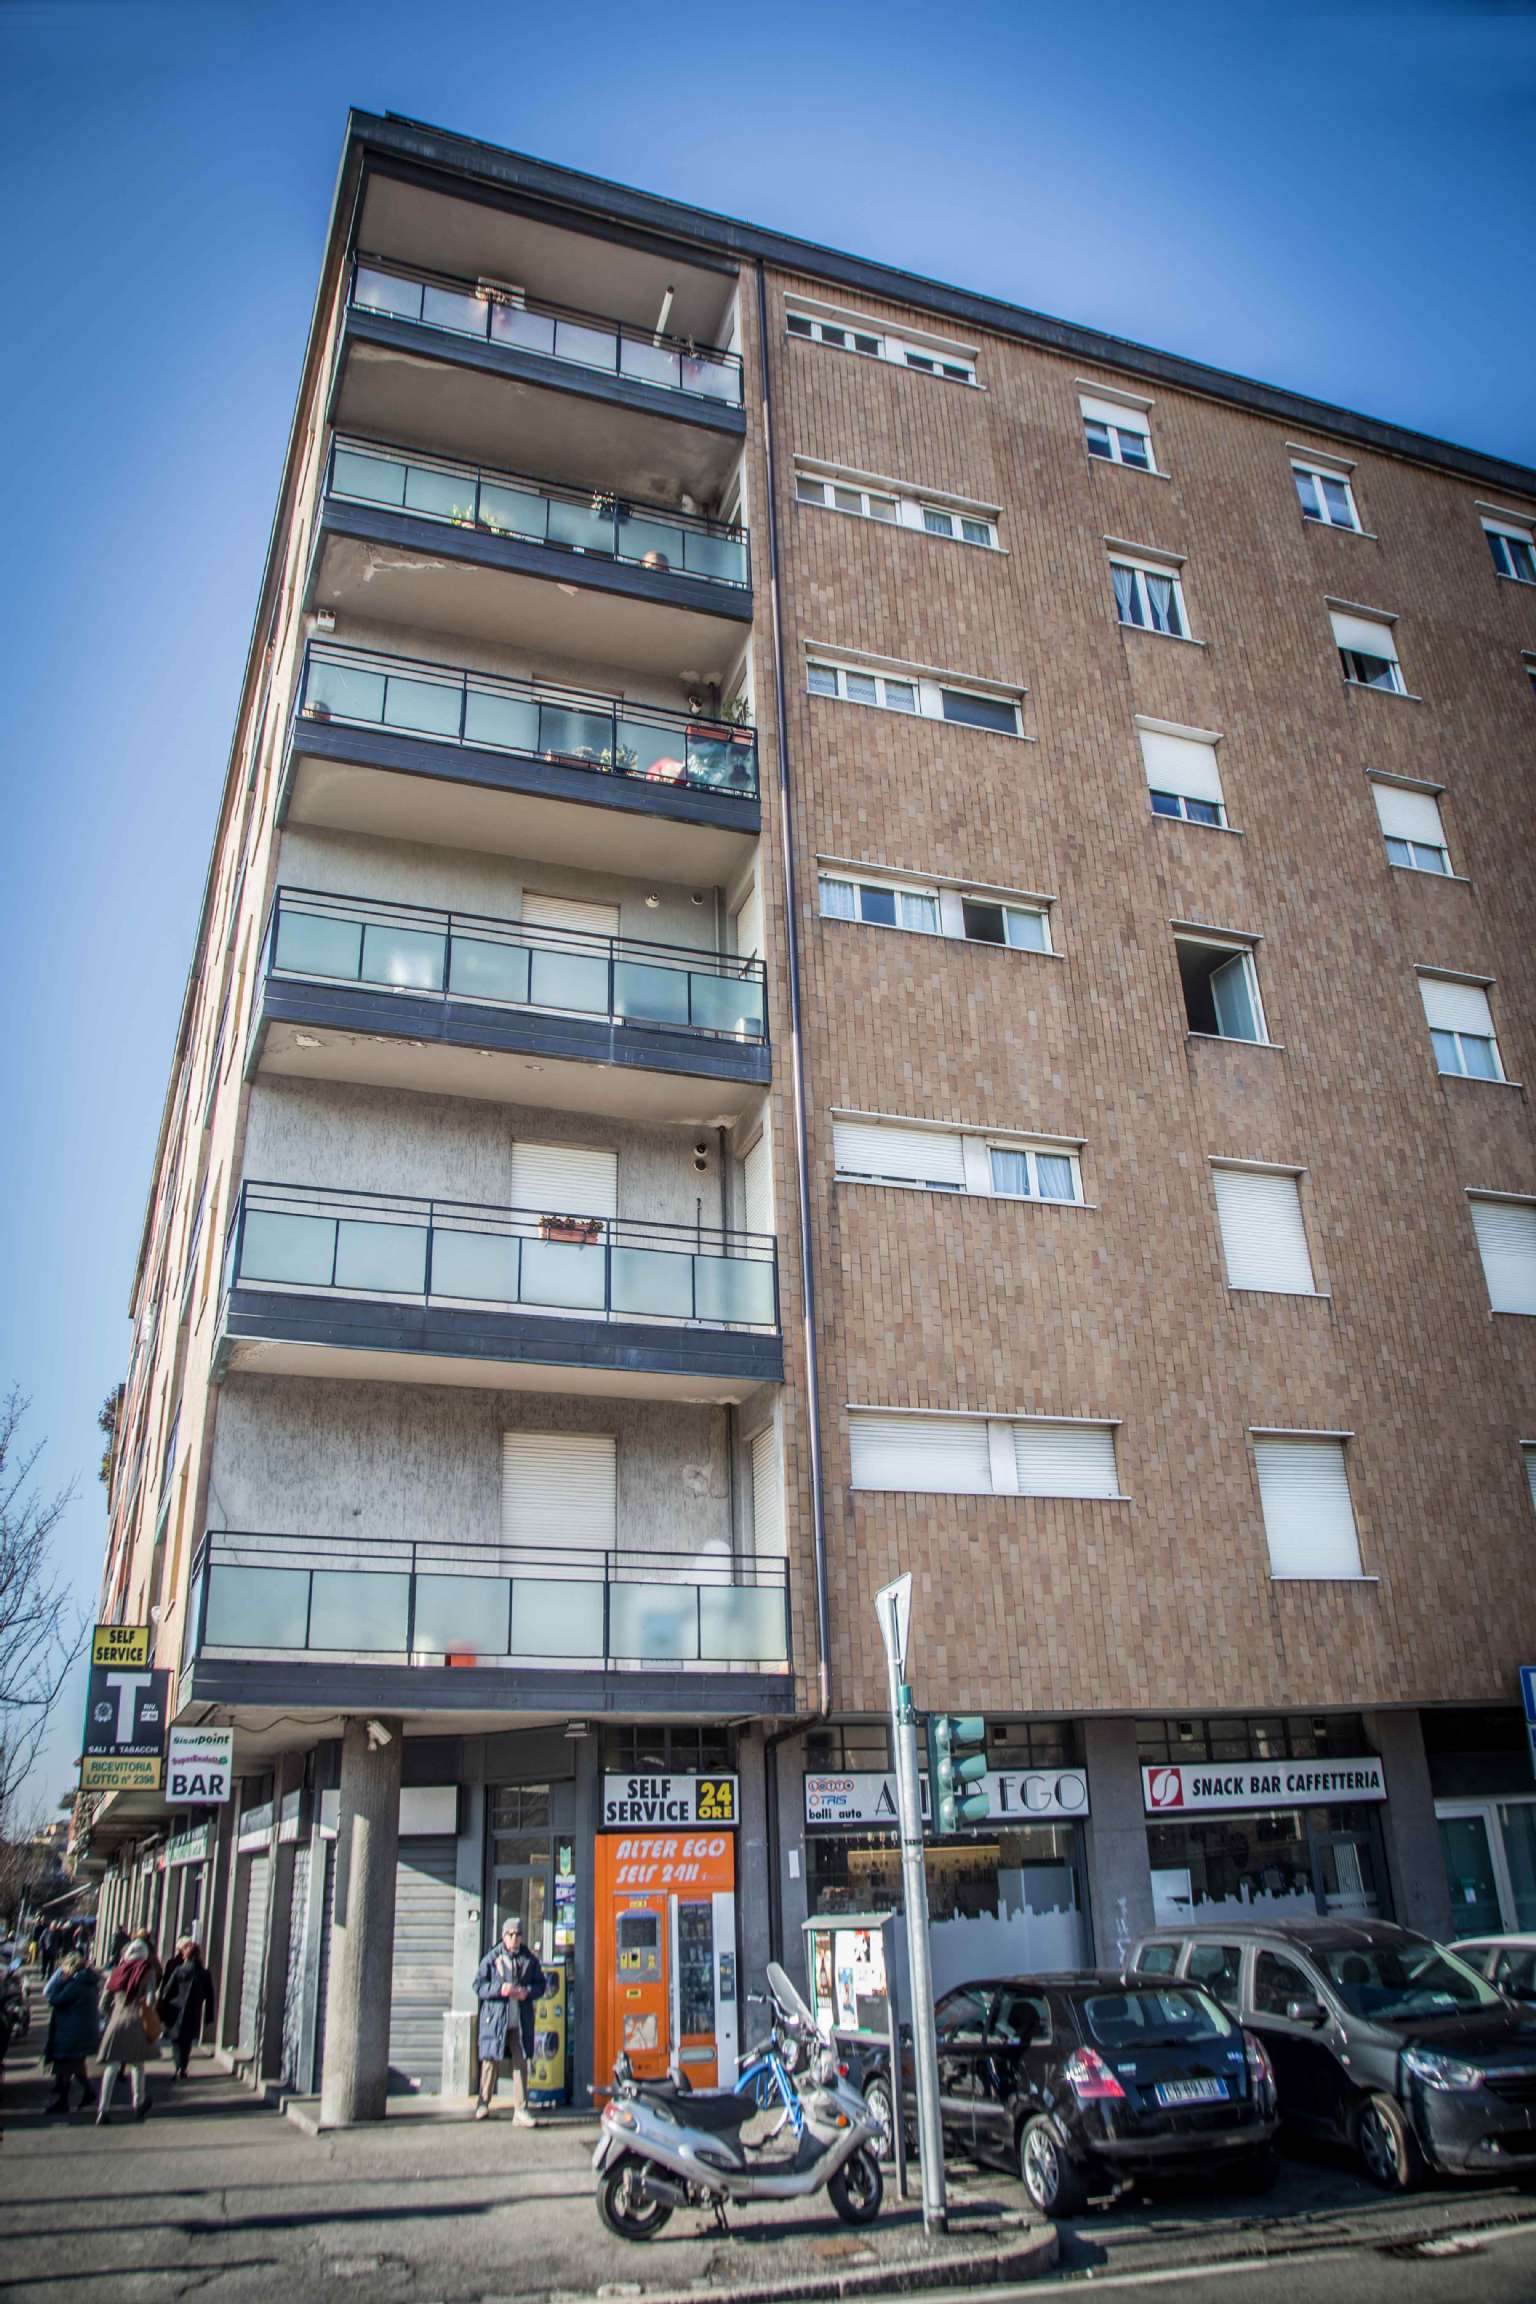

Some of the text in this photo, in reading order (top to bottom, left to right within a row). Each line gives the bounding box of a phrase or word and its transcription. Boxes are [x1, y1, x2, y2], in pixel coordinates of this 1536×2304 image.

[109, 1629, 135, 1644] SELF
[96, 1646, 143, 1662] SERVICE
[106, 1672, 152, 1743] T
[88, 1745, 107, 1754] SALI
[120, 1745, 159, 1754] TABACCHI
[90, 1762, 152, 1772] RICEVITORIA
[86, 1774, 119, 1785] LOTTO
[172, 1774, 224, 1796] BAR
[627, 1778, 671, 1799] SELF
[1192, 1771, 1381, 1797] SNACK BAR CAFFETTERIA
[700, 1782, 732, 1806] 24
[998, 1774, 1086, 1812] EGO
[606, 1800, 689, 1822] SERVICE
[698, 1806, 732, 1819] ORE
[809, 1808, 862, 1820] bolli auto
[616, 1838, 726, 1860] ALTER EGO
[662, 1863, 700, 1883] 24H
